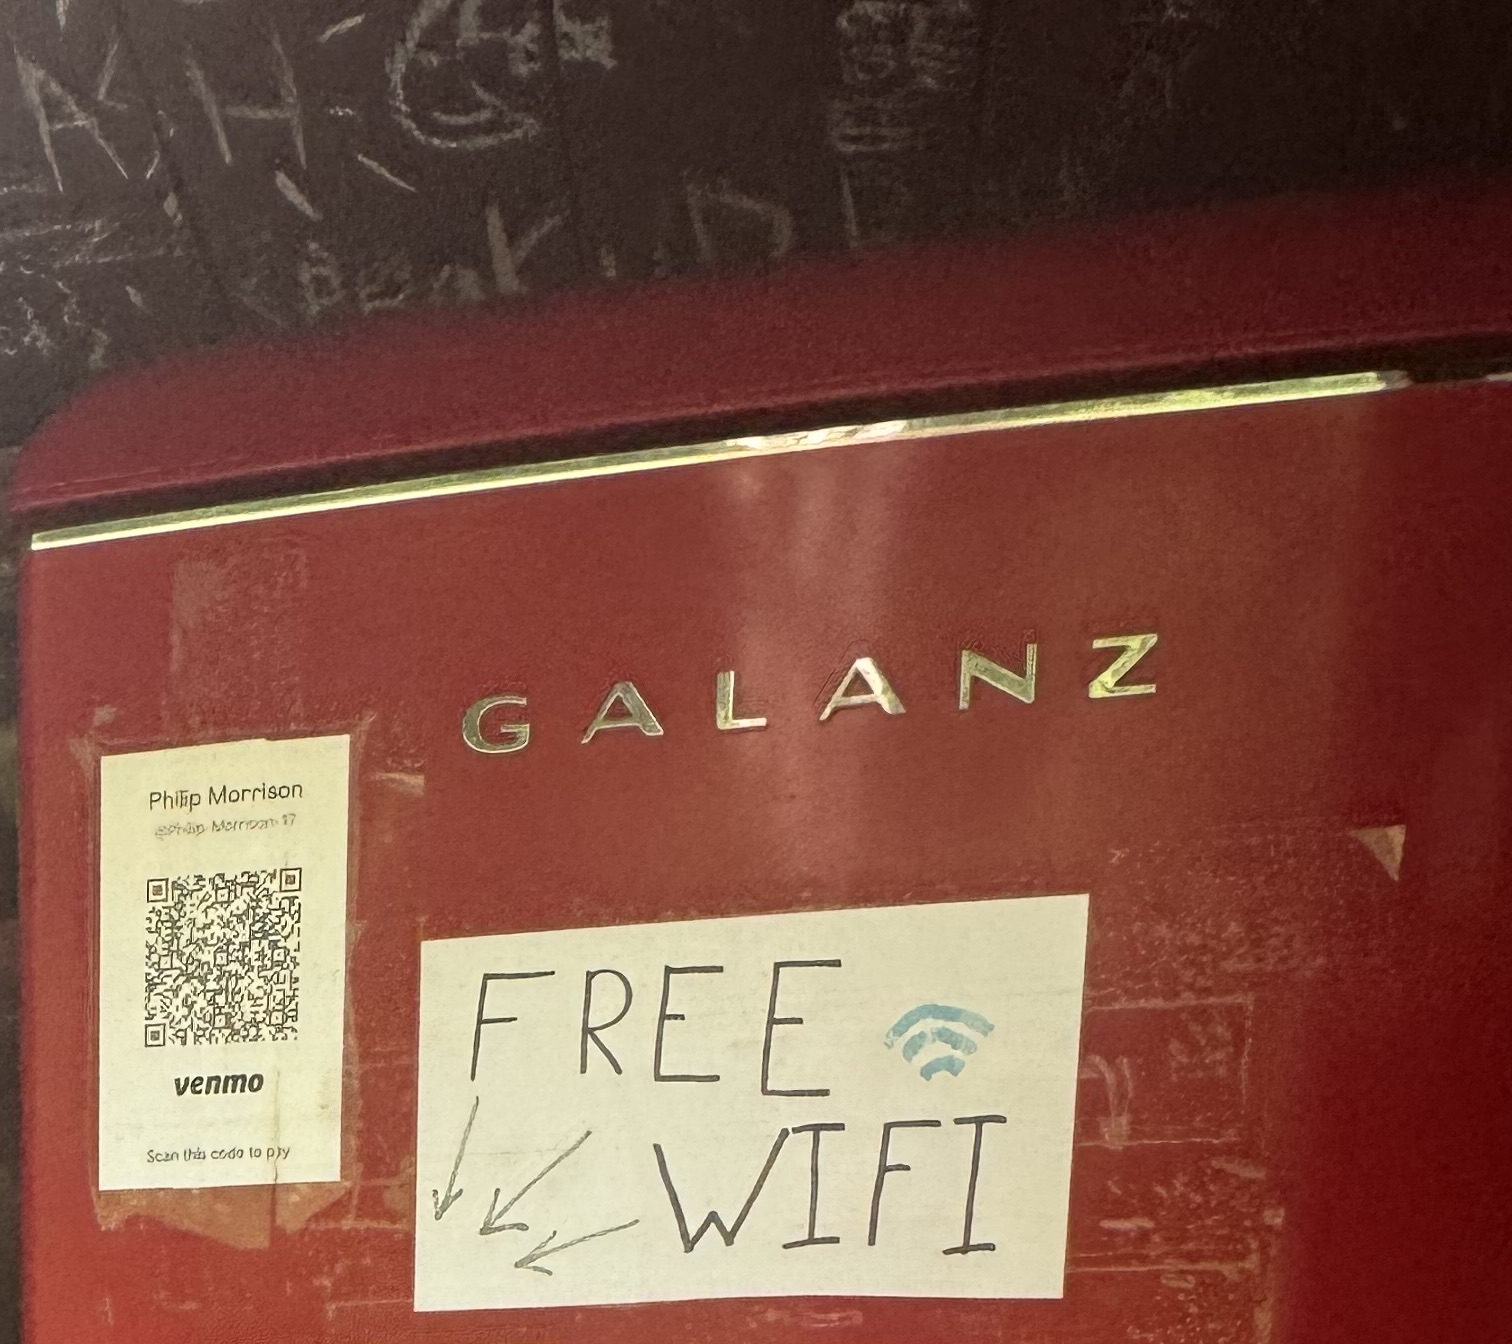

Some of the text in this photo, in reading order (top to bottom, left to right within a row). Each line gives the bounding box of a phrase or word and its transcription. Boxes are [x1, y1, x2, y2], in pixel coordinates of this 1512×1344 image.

[458, 632, 1159, 754] GALANZ
[148, 782, 304, 813] Philip Morrison
[468, 958, 843, 1099] FREE
[173, 1072, 265, 1098] venmo
[248, 1146, 262, 1158] to
[651, 1112, 1008, 1256] WIFI
